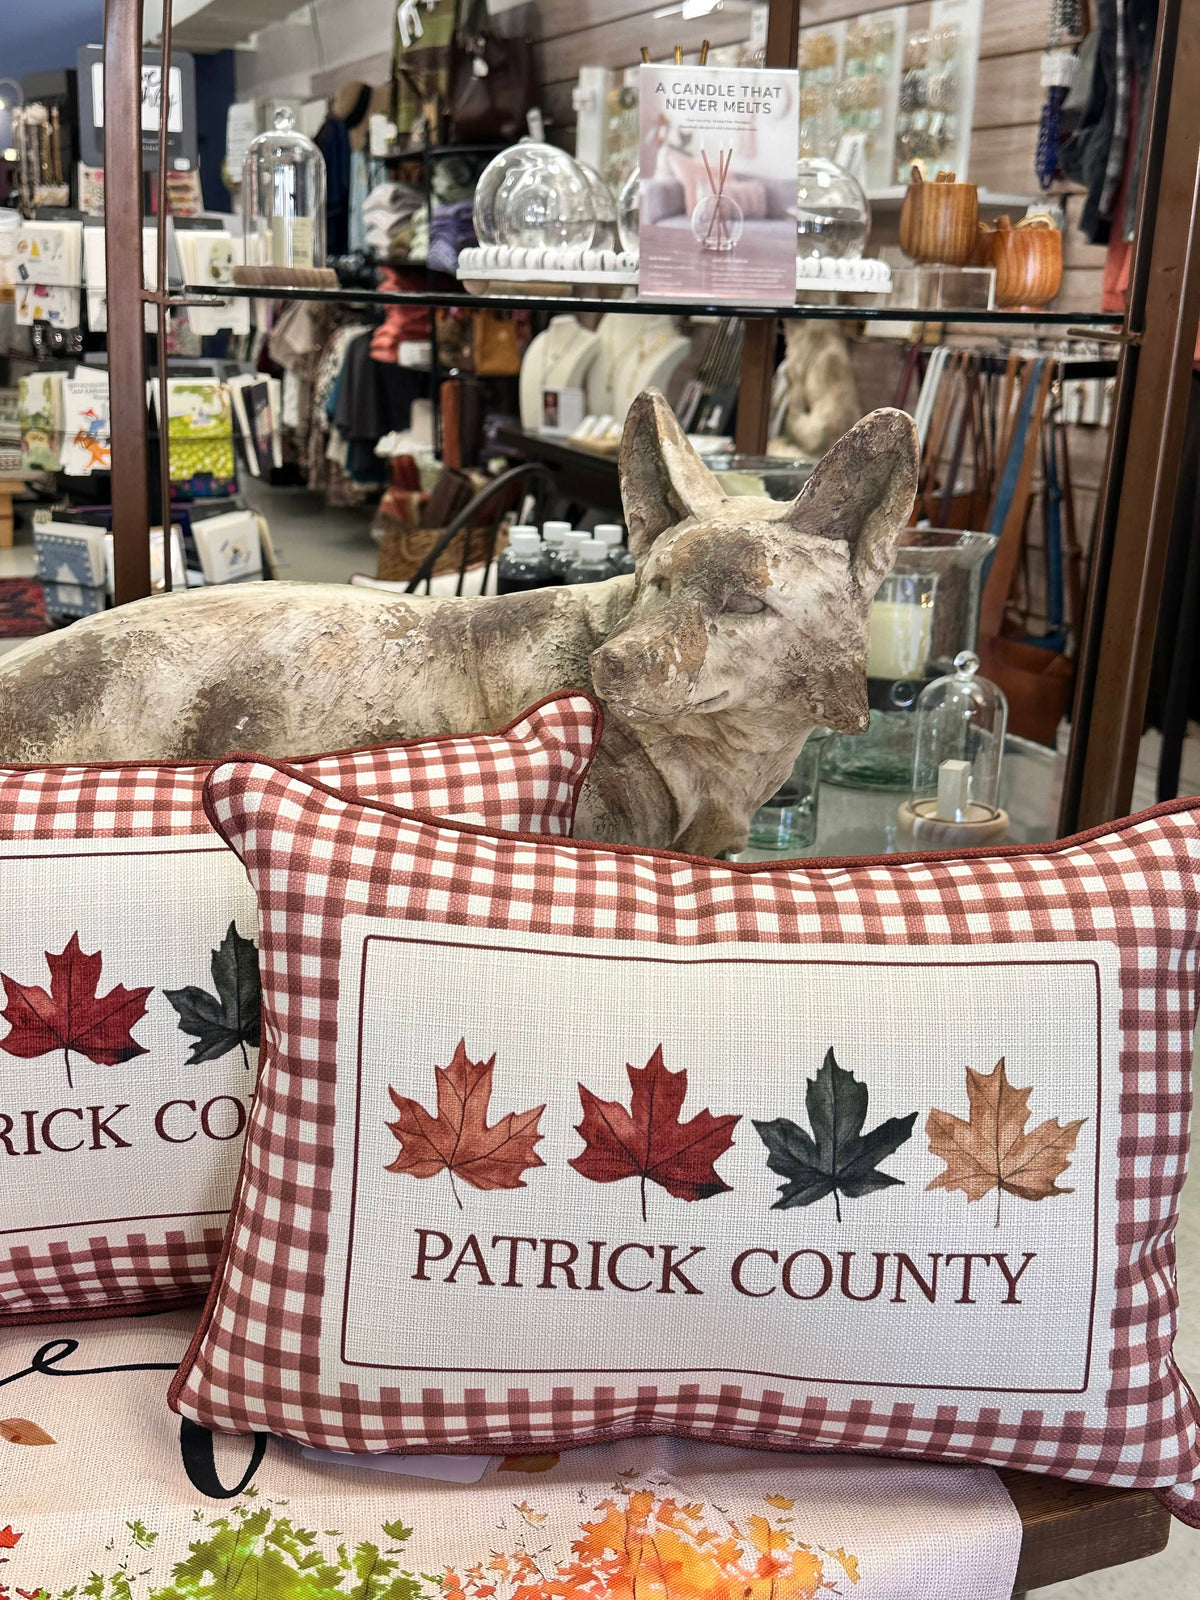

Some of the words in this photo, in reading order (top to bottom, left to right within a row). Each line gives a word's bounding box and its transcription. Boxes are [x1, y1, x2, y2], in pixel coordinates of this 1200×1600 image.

[655, 82, 666, 94] A
[671, 82, 735, 97] CANDLE
[740, 85, 782, 99] THAT
[665, 98, 717, 112] NEVER
[723, 101, 771, 115] MELTS
[154, 1095, 252, 1144] CO
[411, 1228, 706, 1295] PATRICK
[731, 1248, 1037, 1304] COUNTY
